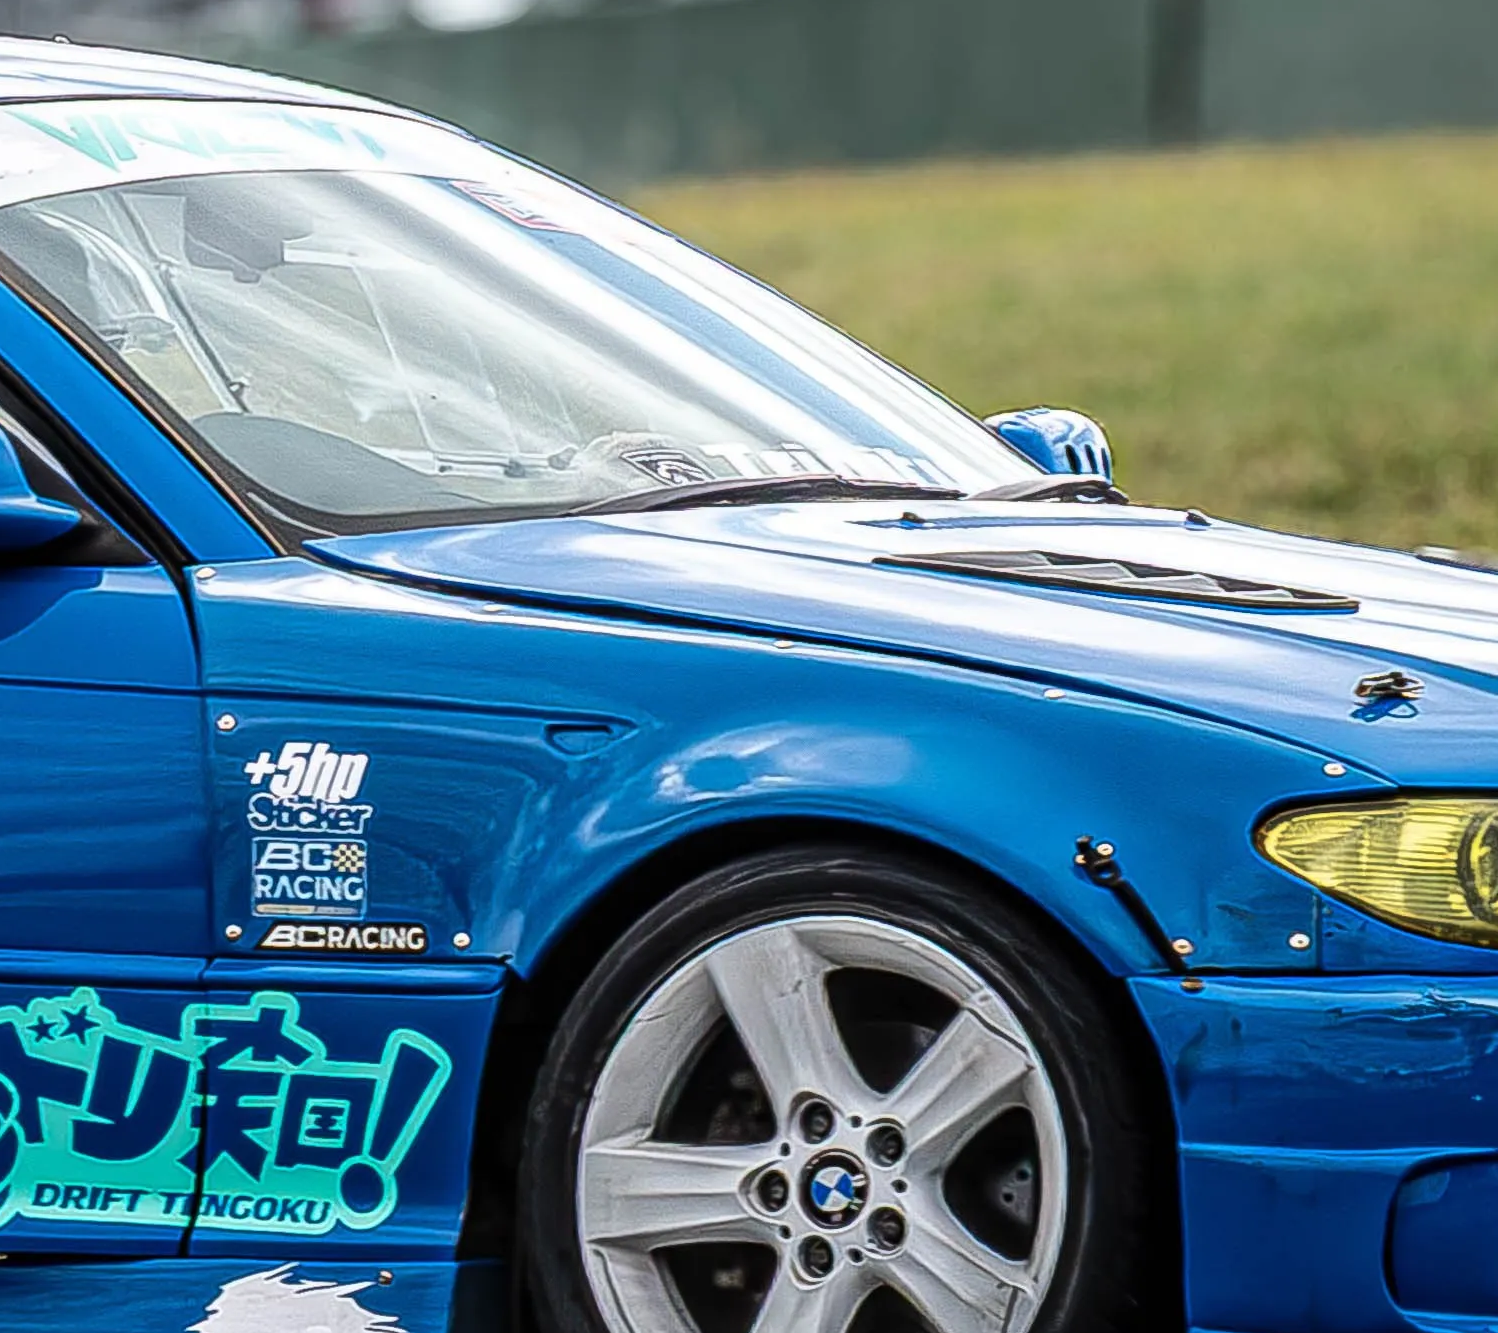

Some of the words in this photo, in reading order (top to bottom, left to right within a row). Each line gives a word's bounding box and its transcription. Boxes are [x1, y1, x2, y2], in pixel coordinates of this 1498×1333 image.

[244, 741, 369, 803] +5hp
[257, 842, 333, 871] BC
[255, 875, 364, 900] RACING
[32, 1183, 151, 1212] DRIFT
